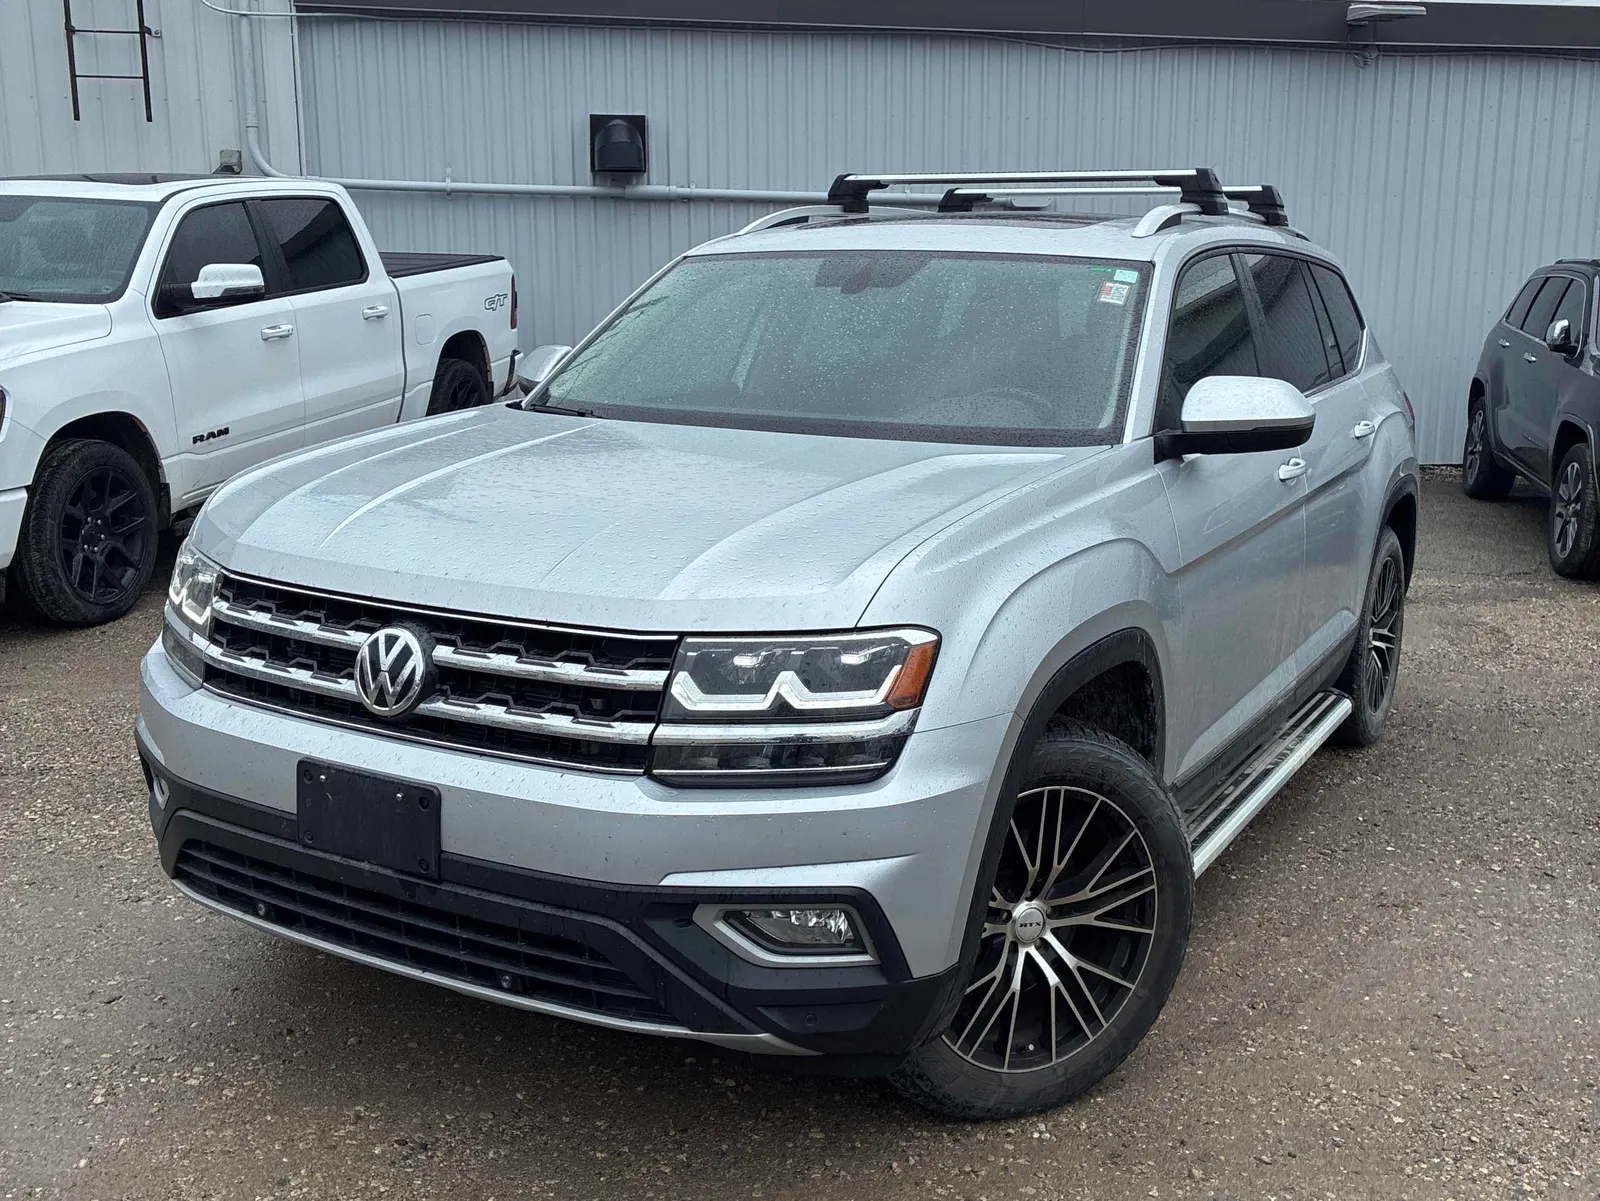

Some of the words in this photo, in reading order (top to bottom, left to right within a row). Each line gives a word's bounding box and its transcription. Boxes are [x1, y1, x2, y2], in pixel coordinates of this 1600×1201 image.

[484, 293, 508, 311] GT
[192, 426, 230, 445] RAM
[358, 630, 421, 712] VW
